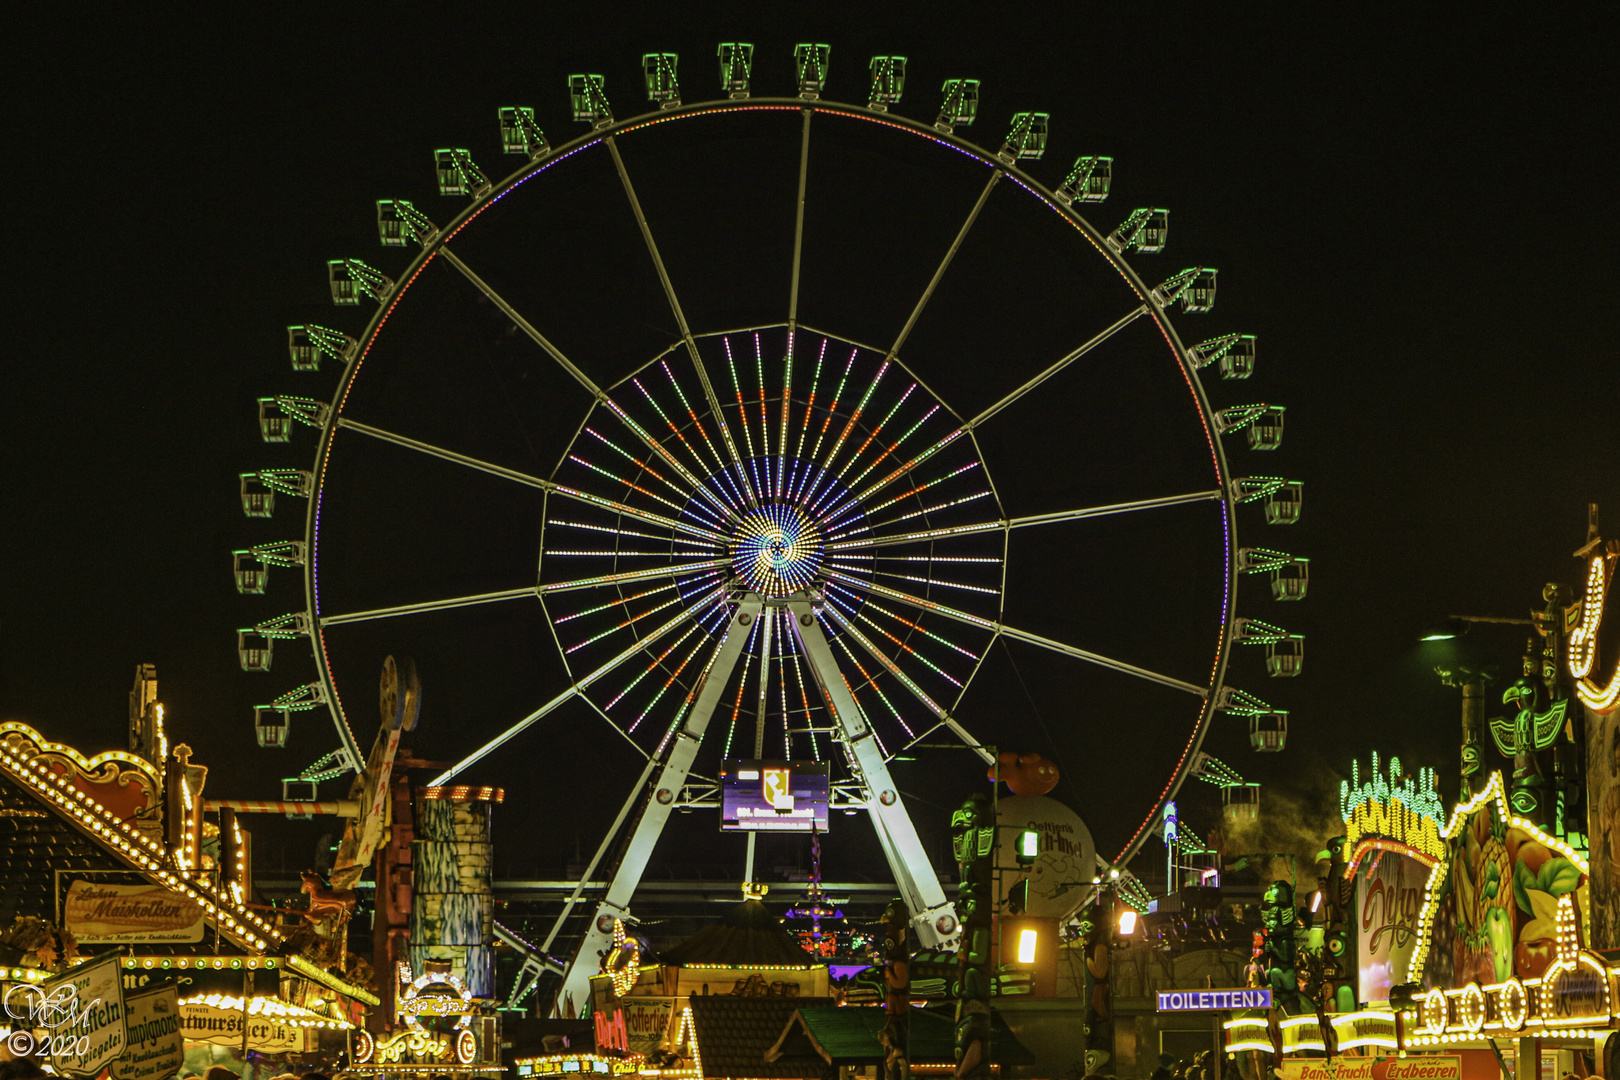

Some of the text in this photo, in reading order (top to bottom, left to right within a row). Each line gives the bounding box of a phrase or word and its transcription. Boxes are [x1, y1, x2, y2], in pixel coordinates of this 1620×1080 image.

[85, 900, 181, 919] Maiskolben
[1159, 991, 1254, 1010] TOILETTEN
[624, 1007, 669, 1037] Poffertjes
[77, 1030, 121, 1068] Spiegelei
[1386, 1063, 1457, 1080] Erdbeeren
